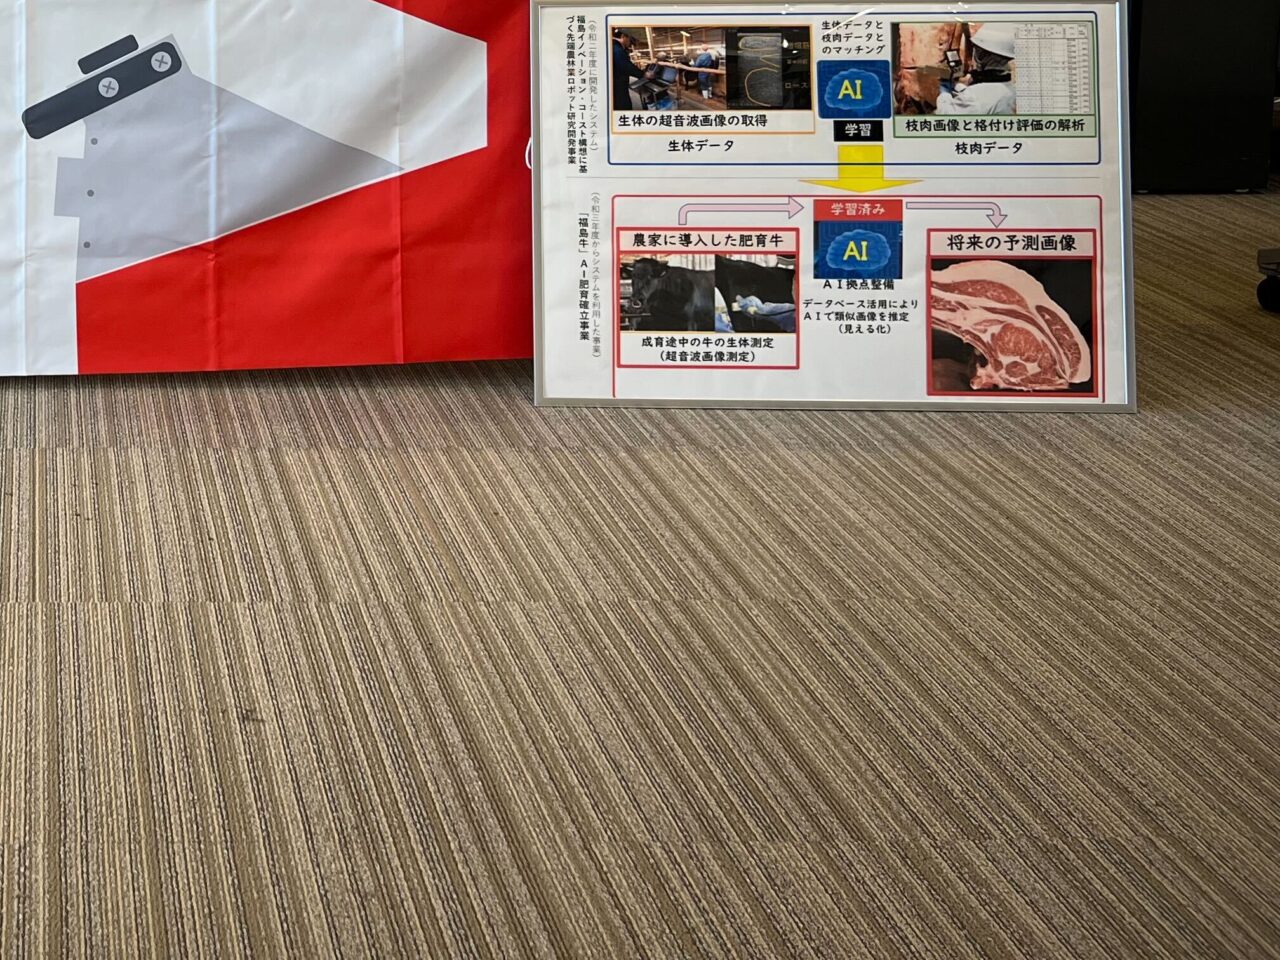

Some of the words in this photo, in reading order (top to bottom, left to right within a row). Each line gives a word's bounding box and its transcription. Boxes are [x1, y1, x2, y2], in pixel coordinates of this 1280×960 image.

[821, 32, 885, 43] 枝肉データと
[822, 44, 886, 55] のマッチング
[838, 79, 863, 100] AI
[618, 113, 768, 128] 生体の超音波画像の取得
[905, 118, 1085, 133] 枝肉画像と格付け評価の解析
[845, 123, 872, 137] 学習
[667, 139, 734, 152] 生体データ
[954, 141, 1023, 155] 枝肉データ
[830, 202, 886, 216] 学習済み
[632, 233, 784, 248] 農家に導入した肥育牛
[946, 234, 1077, 251] 将来の予測画像
[843, 241, 869, 261] AI
[802, 298, 920, 310] データベース活用により
[803, 310, 910, 322] AIで類似画像を推定
[837, 323, 892, 335] （見える化）
[641, 336, 775, 350] 成育途中の牛の生体測定
[660, 350, 756, 364] （超音波画像測定）
